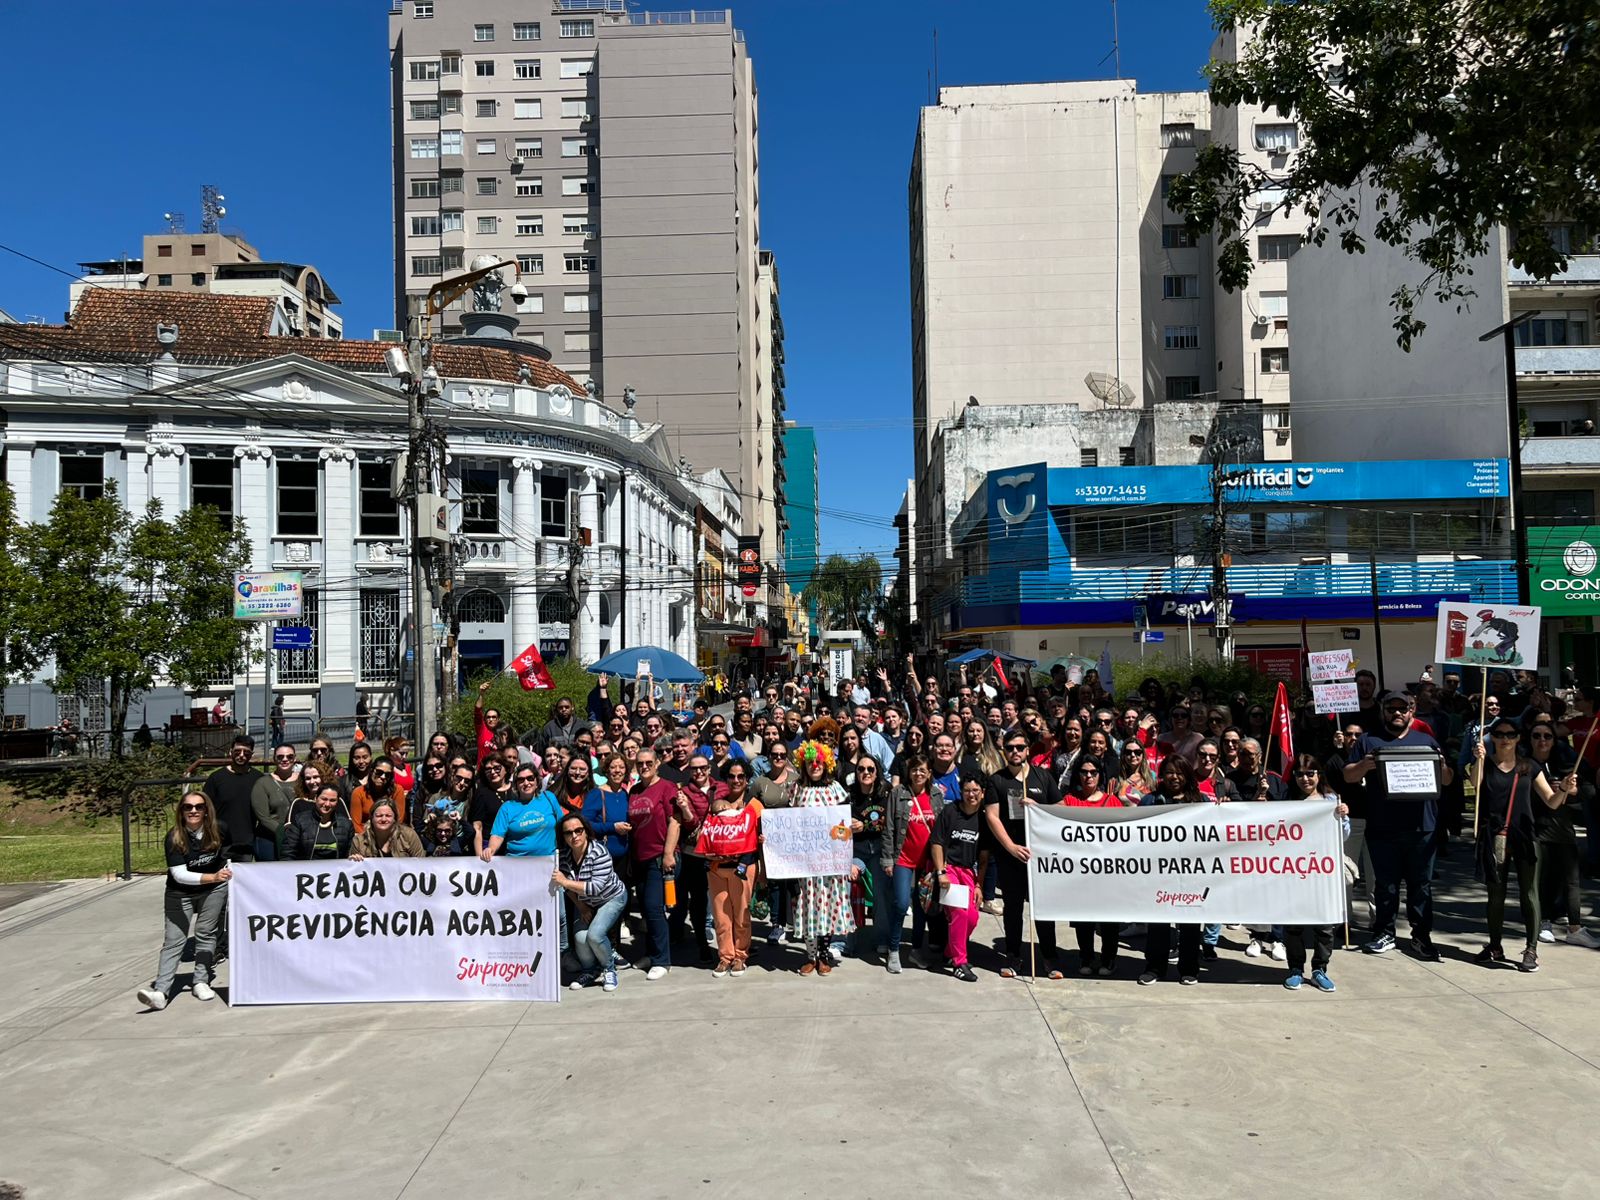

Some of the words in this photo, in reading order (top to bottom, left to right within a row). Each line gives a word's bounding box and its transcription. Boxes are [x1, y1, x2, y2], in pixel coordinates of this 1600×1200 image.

[1540, 578, 1600, 590] ODON
[1312, 653, 1350, 664] PROFESSOR
[1061, 825, 1131, 842] GASTOU
[1137, 825, 1187, 842] TUDO
[1194, 826, 1220, 842] NA
[1226, 820, 1303, 846] ELEIÇÃO
[1037, 852, 1074, 874] NÃO
[1080, 857, 1151, 874] SOBROU
[1159, 856, 1205, 874] PARA
[1212, 857, 1224, 874] A
[1230, 852, 1334, 879] EDUCAÇÃO
[296, 872, 386, 900] REAJA
[399, 872, 437, 896] OU
[449, 870, 499, 896] SUA
[247, 905, 434, 942] PREVIDÊNCIA
[447, 908, 543, 937] ACABA!
